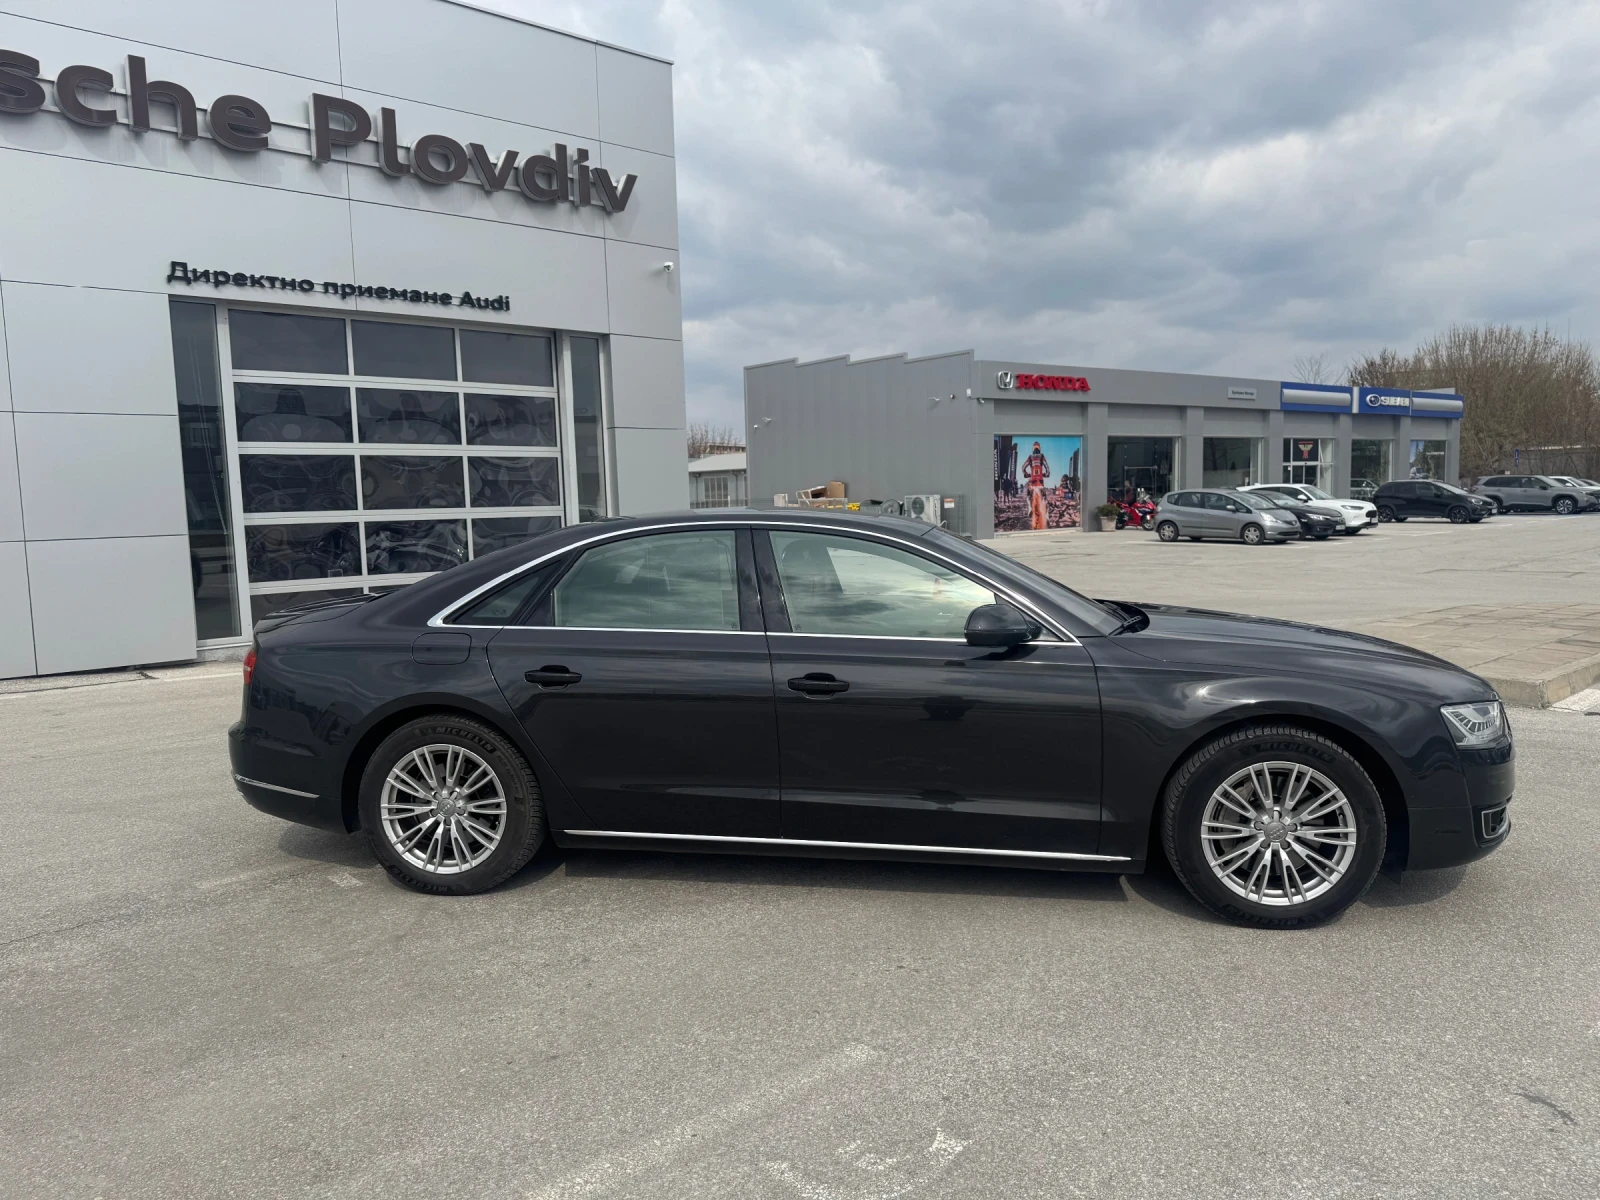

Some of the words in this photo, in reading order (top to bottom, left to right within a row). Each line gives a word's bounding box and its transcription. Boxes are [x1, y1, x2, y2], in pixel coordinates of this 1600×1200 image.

[308, 92, 638, 213] Plovdiv
[167, 261, 315, 293] Директно
[323, 281, 453, 305] приемане
[459, 291, 510, 312] Audi
[1016, 373, 1091, 392] HONDA
[435, 726, 495, 752] MICHELIN
